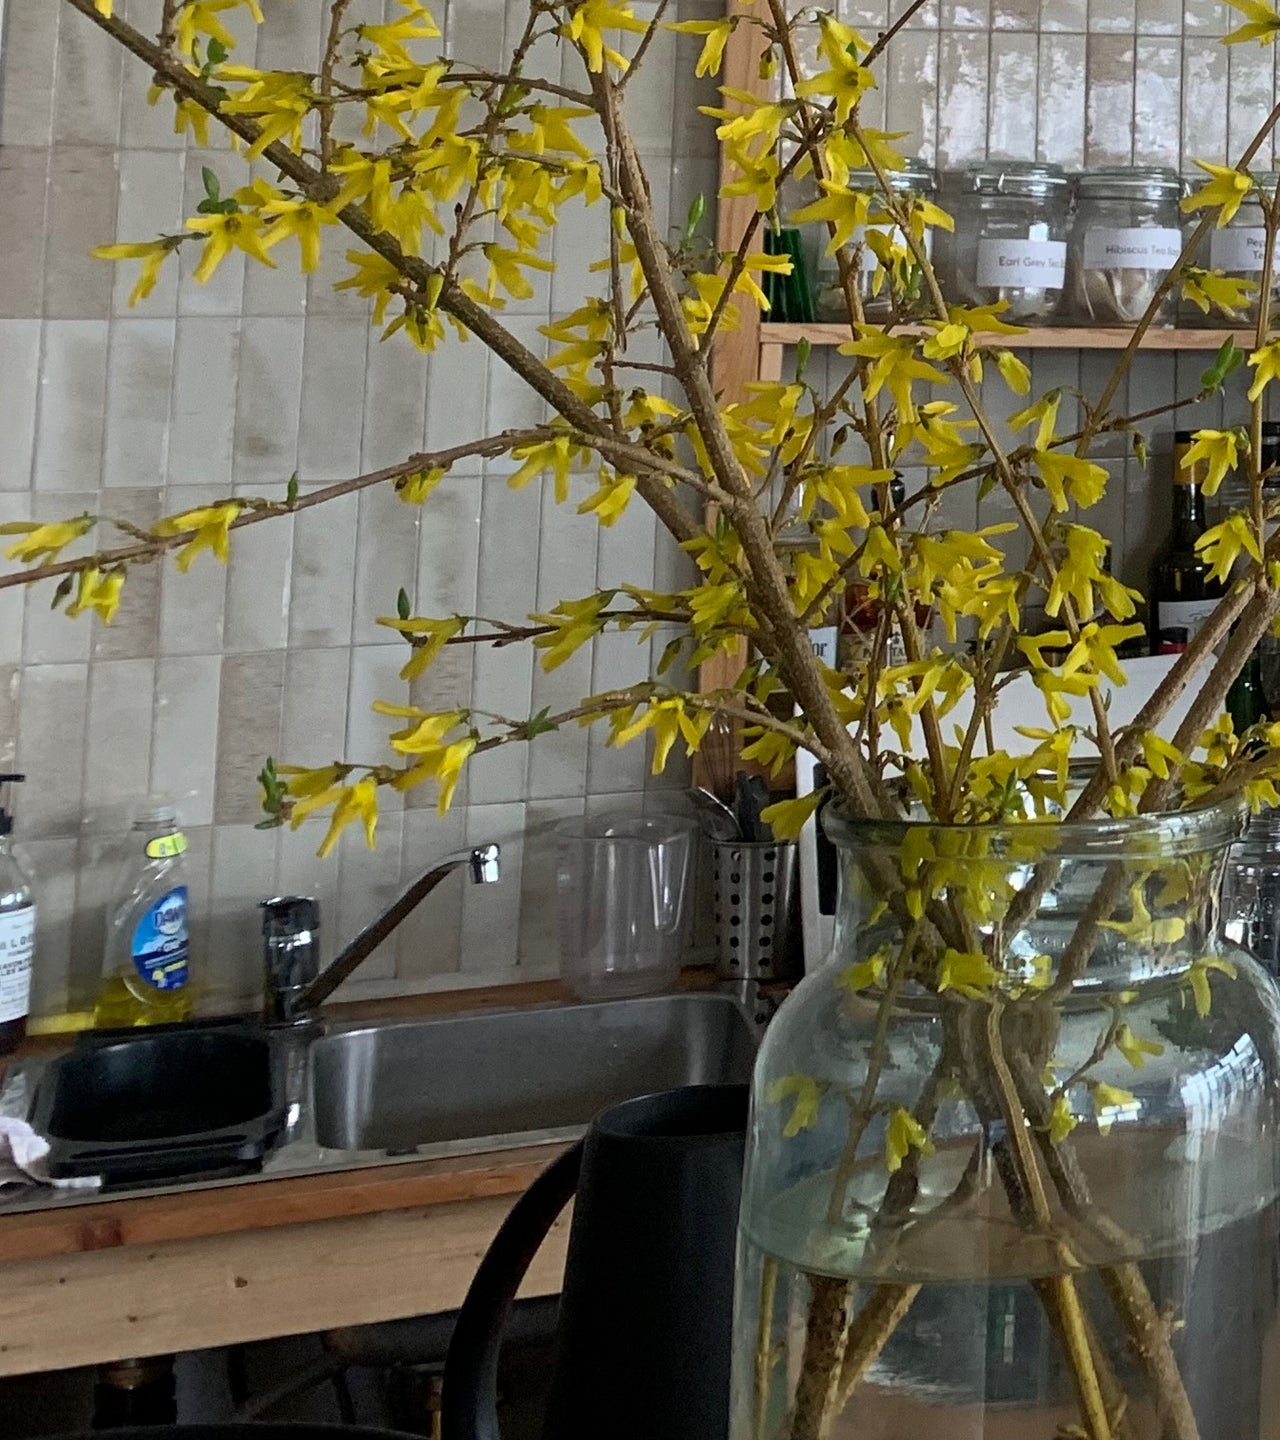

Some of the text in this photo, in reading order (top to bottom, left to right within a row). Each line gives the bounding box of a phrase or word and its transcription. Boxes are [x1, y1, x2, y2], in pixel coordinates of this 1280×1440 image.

[1106, 244, 1148, 255] Hibiscus
[998, 256, 1020, 267] Earl
[1024, 256, 1046, 268] Grey
